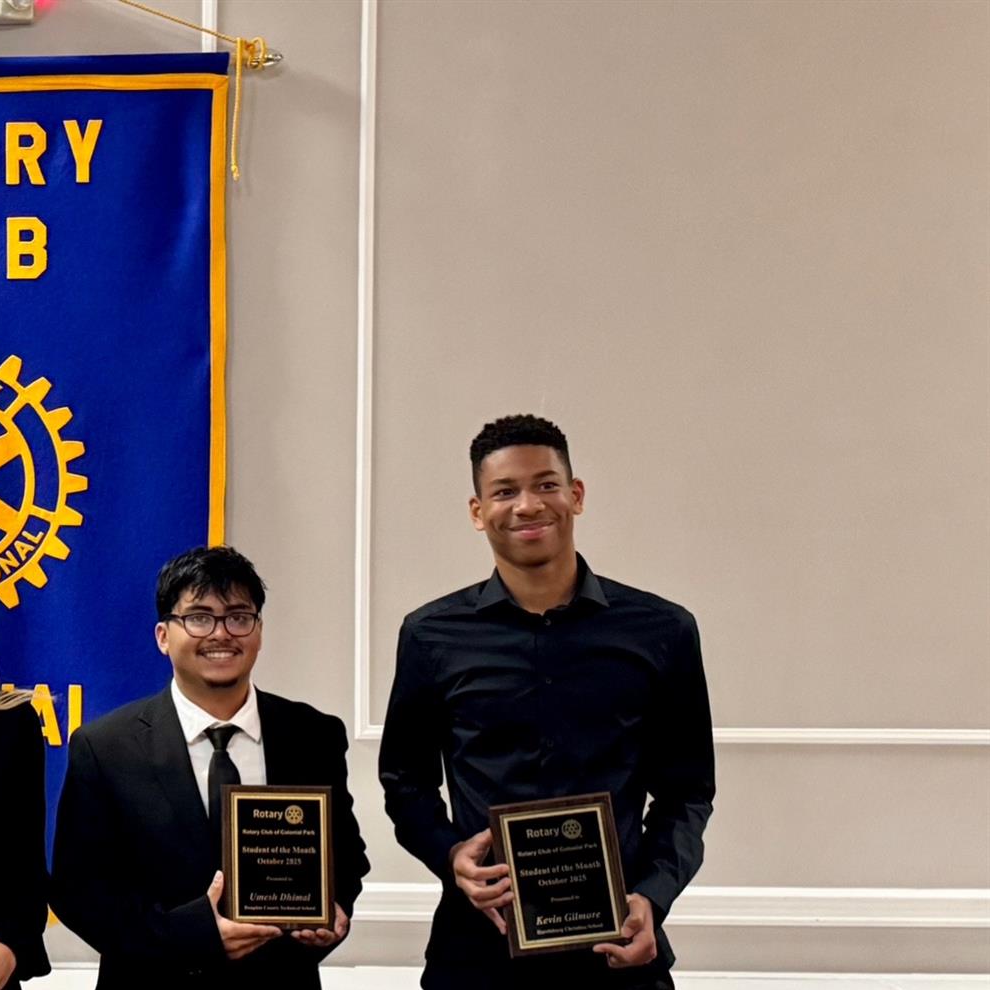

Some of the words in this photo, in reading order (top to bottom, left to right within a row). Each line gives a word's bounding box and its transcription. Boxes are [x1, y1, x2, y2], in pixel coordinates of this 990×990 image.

[253, 809, 283, 820] Rotary
[526, 827, 559, 839] Rotary
[242, 846, 270, 854] Student
[271, 846, 278, 854] of
[279, 846, 290, 854] the
[292, 846, 316, 854] Month
[519, 868, 550, 877] Student
[552, 865, 559, 873] of
[561, 863, 573, 872] the
[575, 861, 601, 870] Month
[538, 878, 567, 887] October
[250, 892, 278, 901] Umesh
[536, 914, 562, 926] Kevin
[564, 912, 601, 922] Gilmore
